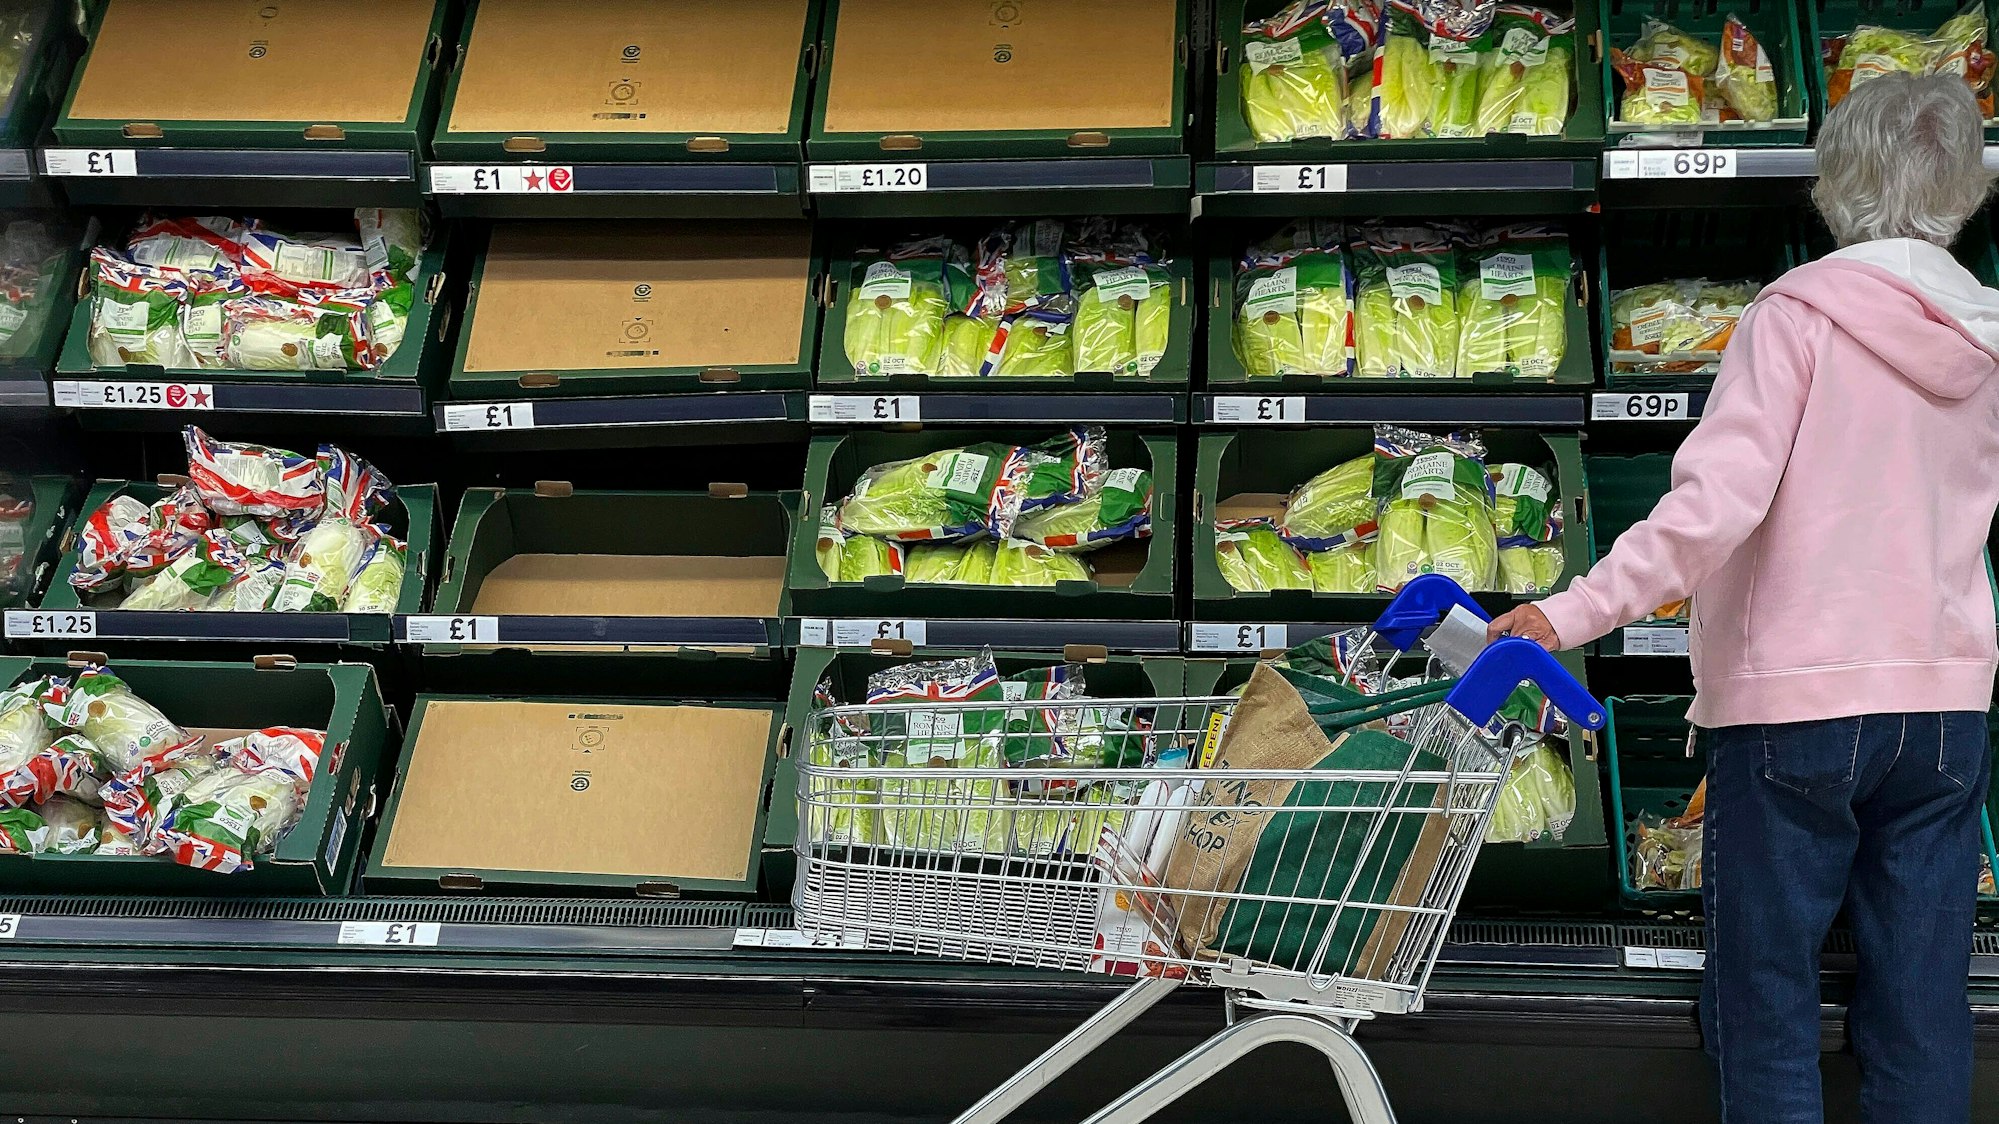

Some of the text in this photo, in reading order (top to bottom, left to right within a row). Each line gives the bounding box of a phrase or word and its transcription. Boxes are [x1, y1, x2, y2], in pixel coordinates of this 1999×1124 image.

[87, 151, 114, 173] £1
[1673, 152, 1727, 174] 69p
[473, 168, 500, 190] £1
[862, 167, 922, 186] £1.20
[1298, 166, 1326, 189] £1
[104, 385, 161, 404] £1.25
[485, 405, 513, 427] £1
[873, 397, 900, 419] £1
[1257, 398, 1285, 420] £1
[1626, 395, 1679, 417] 69p
[1410, 468, 1444, 479] HEARTS
[32, 615, 92, 634] £1.25
[449, 617, 477, 640] £1
[877, 621, 904, 640] £1
[1237, 625, 1265, 648] £1
[151, 720, 164, 730] OCT
[220, 817, 243, 831] TESCO
[384, 923, 417, 943] £1
